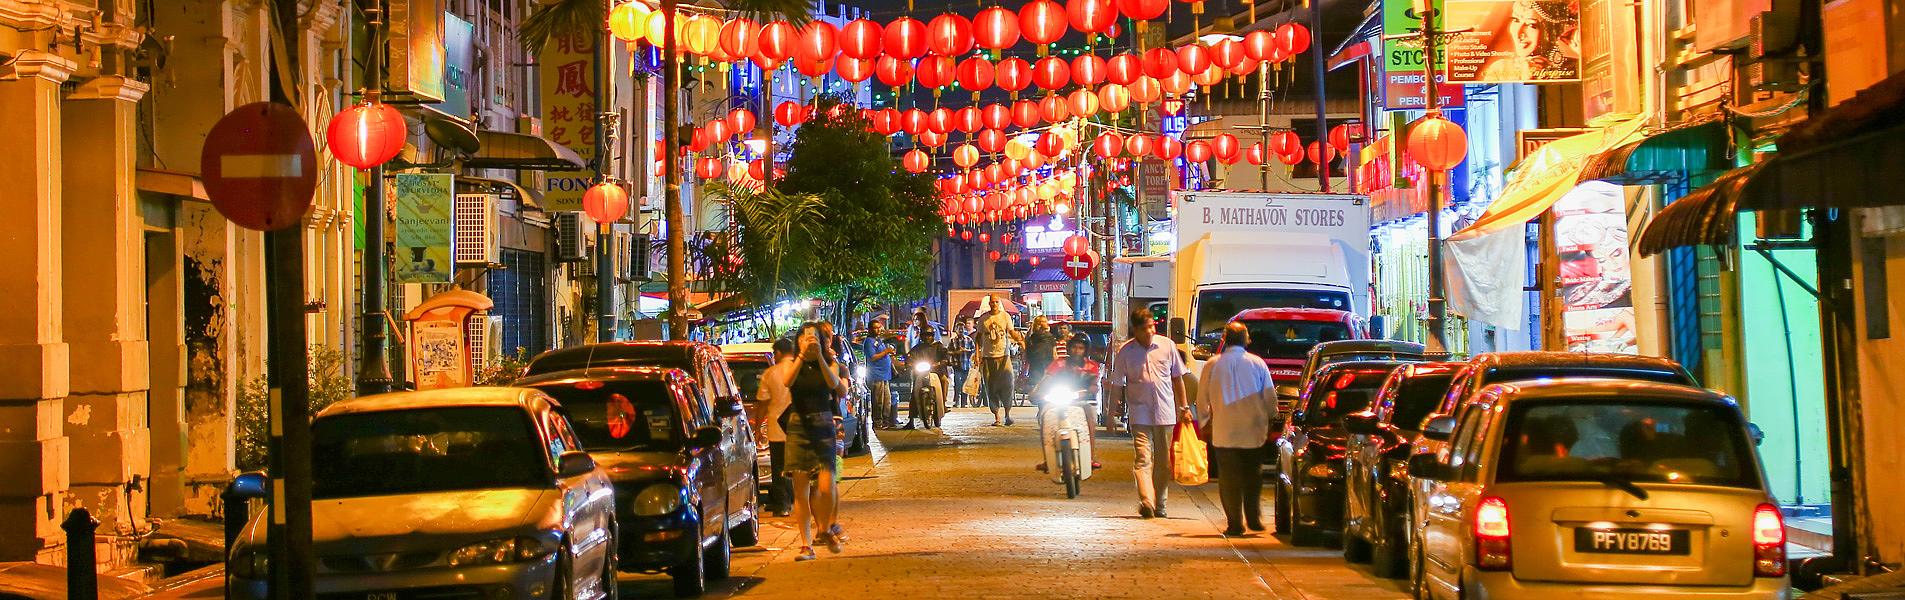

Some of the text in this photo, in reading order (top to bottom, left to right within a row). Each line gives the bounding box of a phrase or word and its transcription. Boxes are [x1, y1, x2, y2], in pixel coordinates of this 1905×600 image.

[1392, 50, 1445, 66] STOE
[547, 178, 592, 193] FON
[1203, 207, 1345, 227] B. MATHAVON STORES
[1593, 531, 1671, 551] PFY8769
